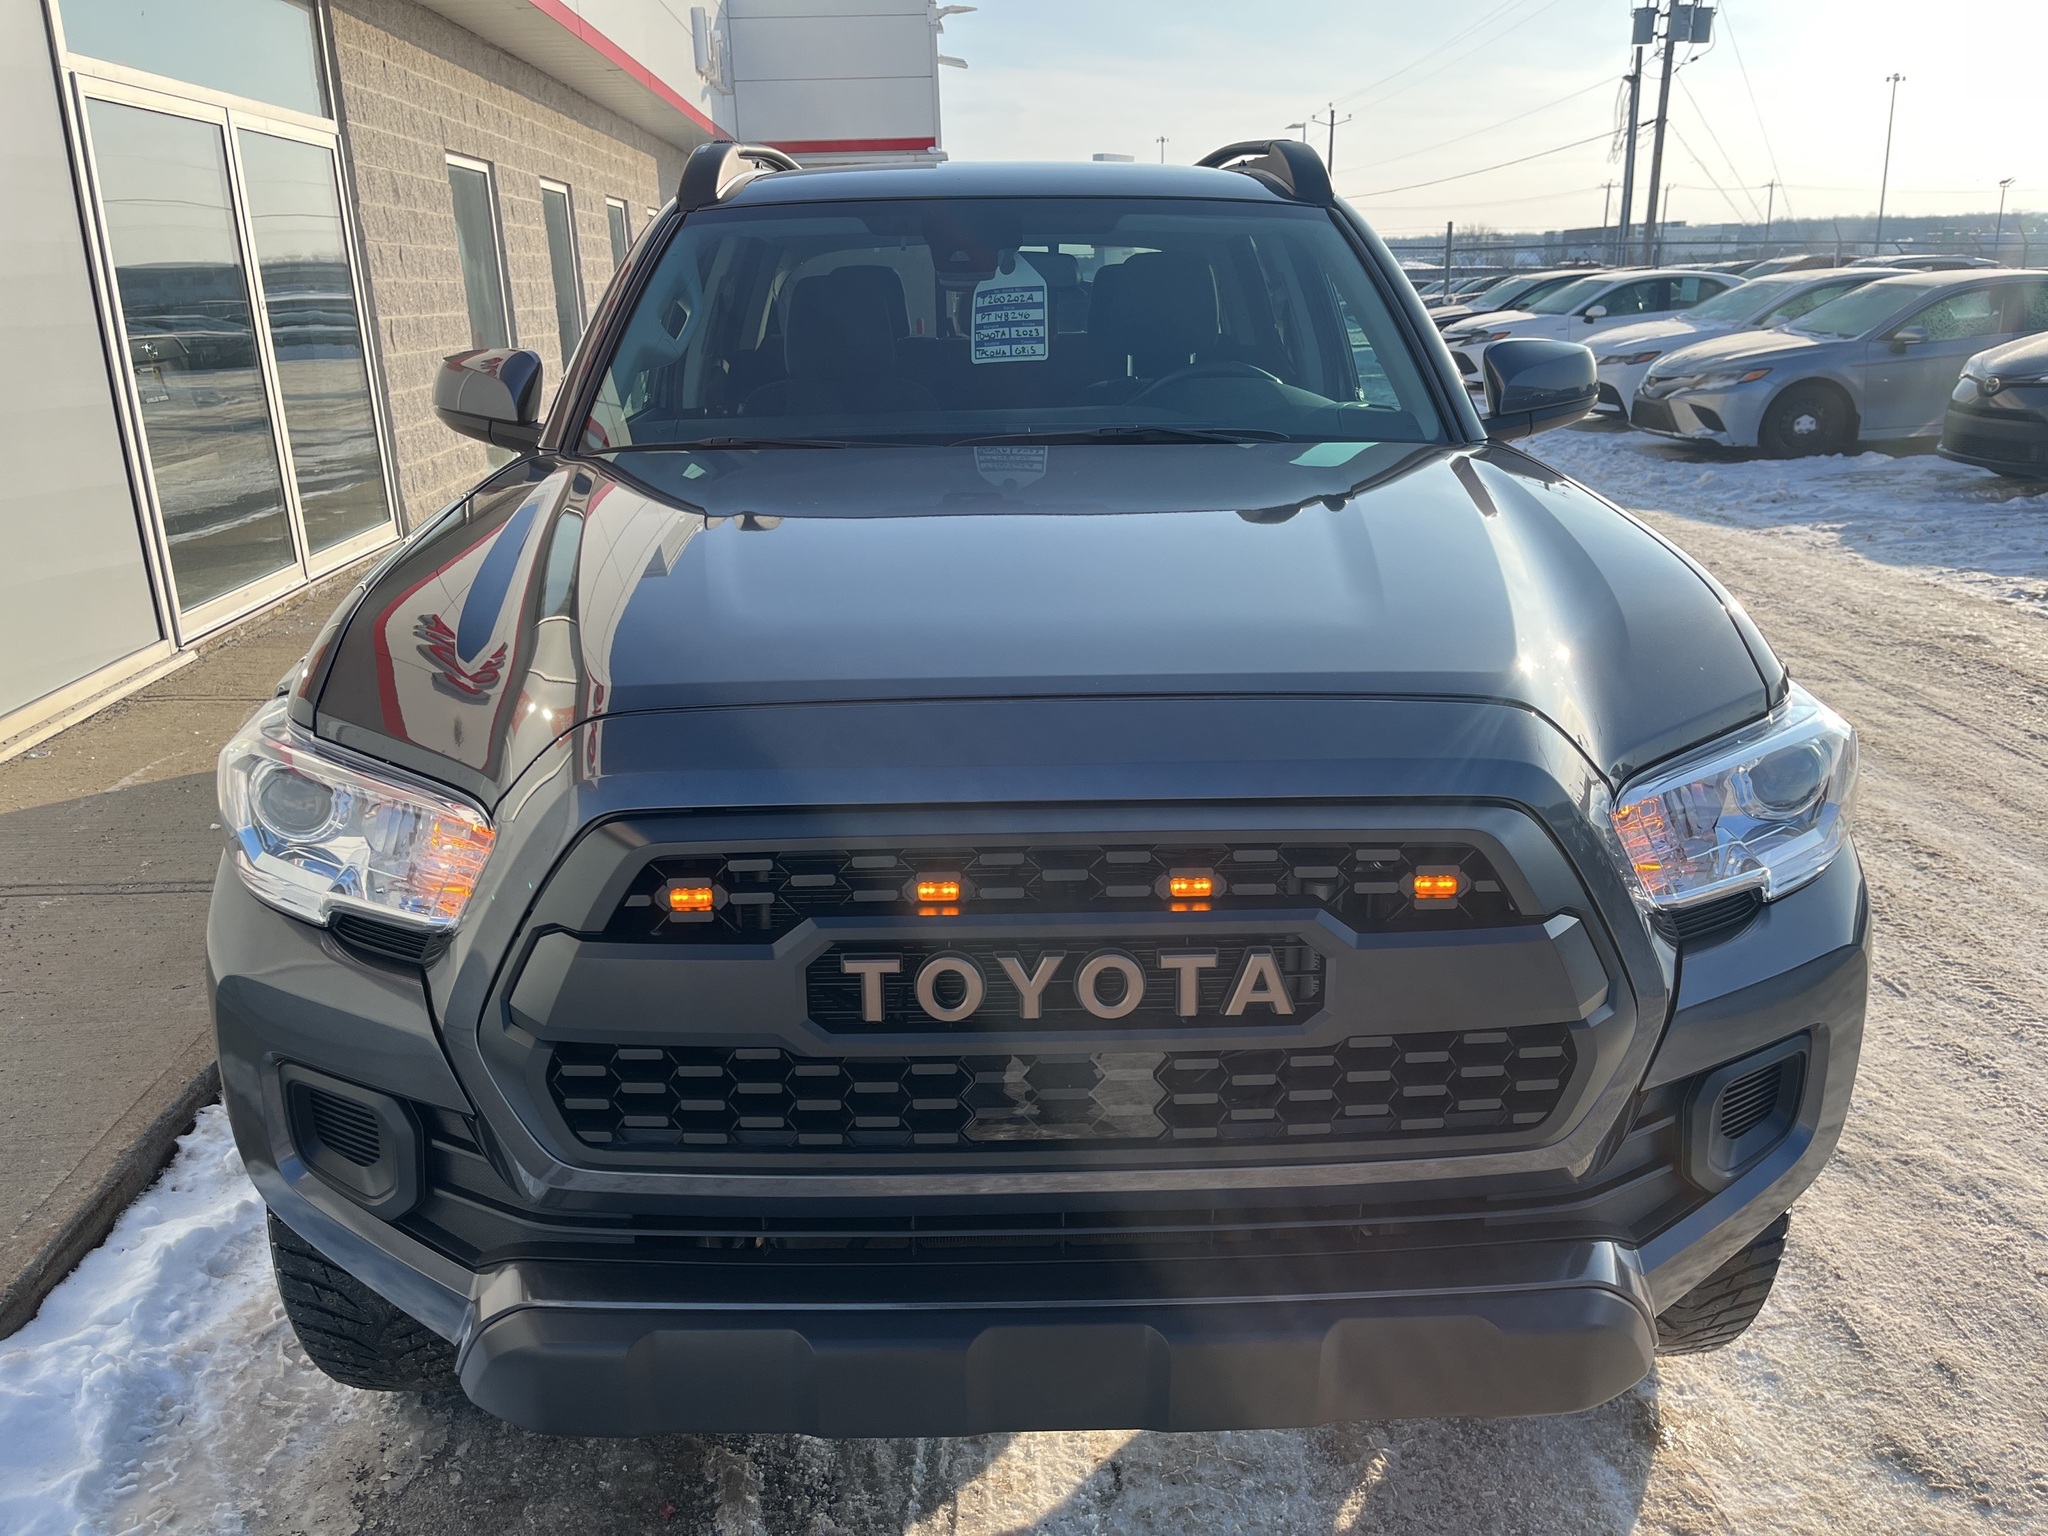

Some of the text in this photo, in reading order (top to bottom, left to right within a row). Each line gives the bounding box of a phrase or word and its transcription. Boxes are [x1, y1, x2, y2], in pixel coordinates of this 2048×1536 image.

[980, 293, 1034, 305] T260202A
[976, 330, 1006, 341] TOYOTA
[1015, 328, 1040, 337] 2023
[842, 950, 1295, 1022] TOYOTA
